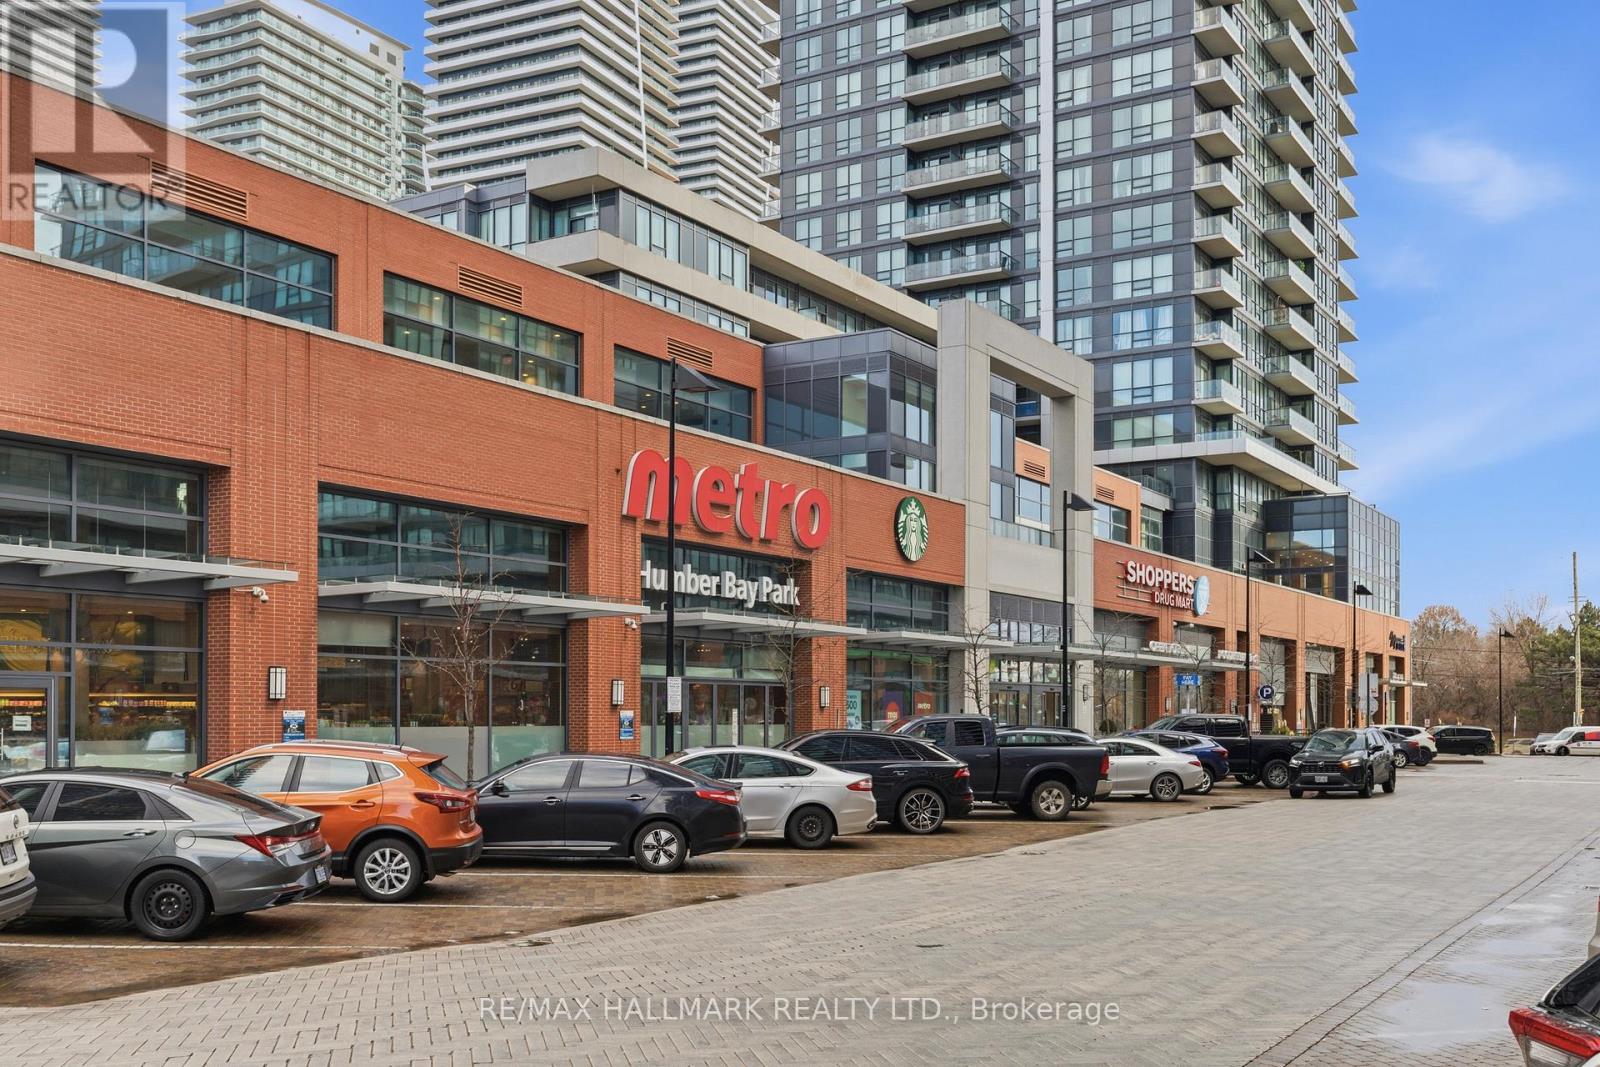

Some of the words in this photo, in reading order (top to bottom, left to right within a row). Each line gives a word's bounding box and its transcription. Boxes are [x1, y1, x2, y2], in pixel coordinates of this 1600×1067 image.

[622, 449, 832, 550] metro
[721, 571, 759, 608] Bay
[758, 576, 801, 606] Park
[1126, 560, 1195, 595] SHOPPERS
[1154, 591, 1175, 606] DRUG
[1175, 595, 1195, 610] MART
[1263, 687, 1272, 697] P
